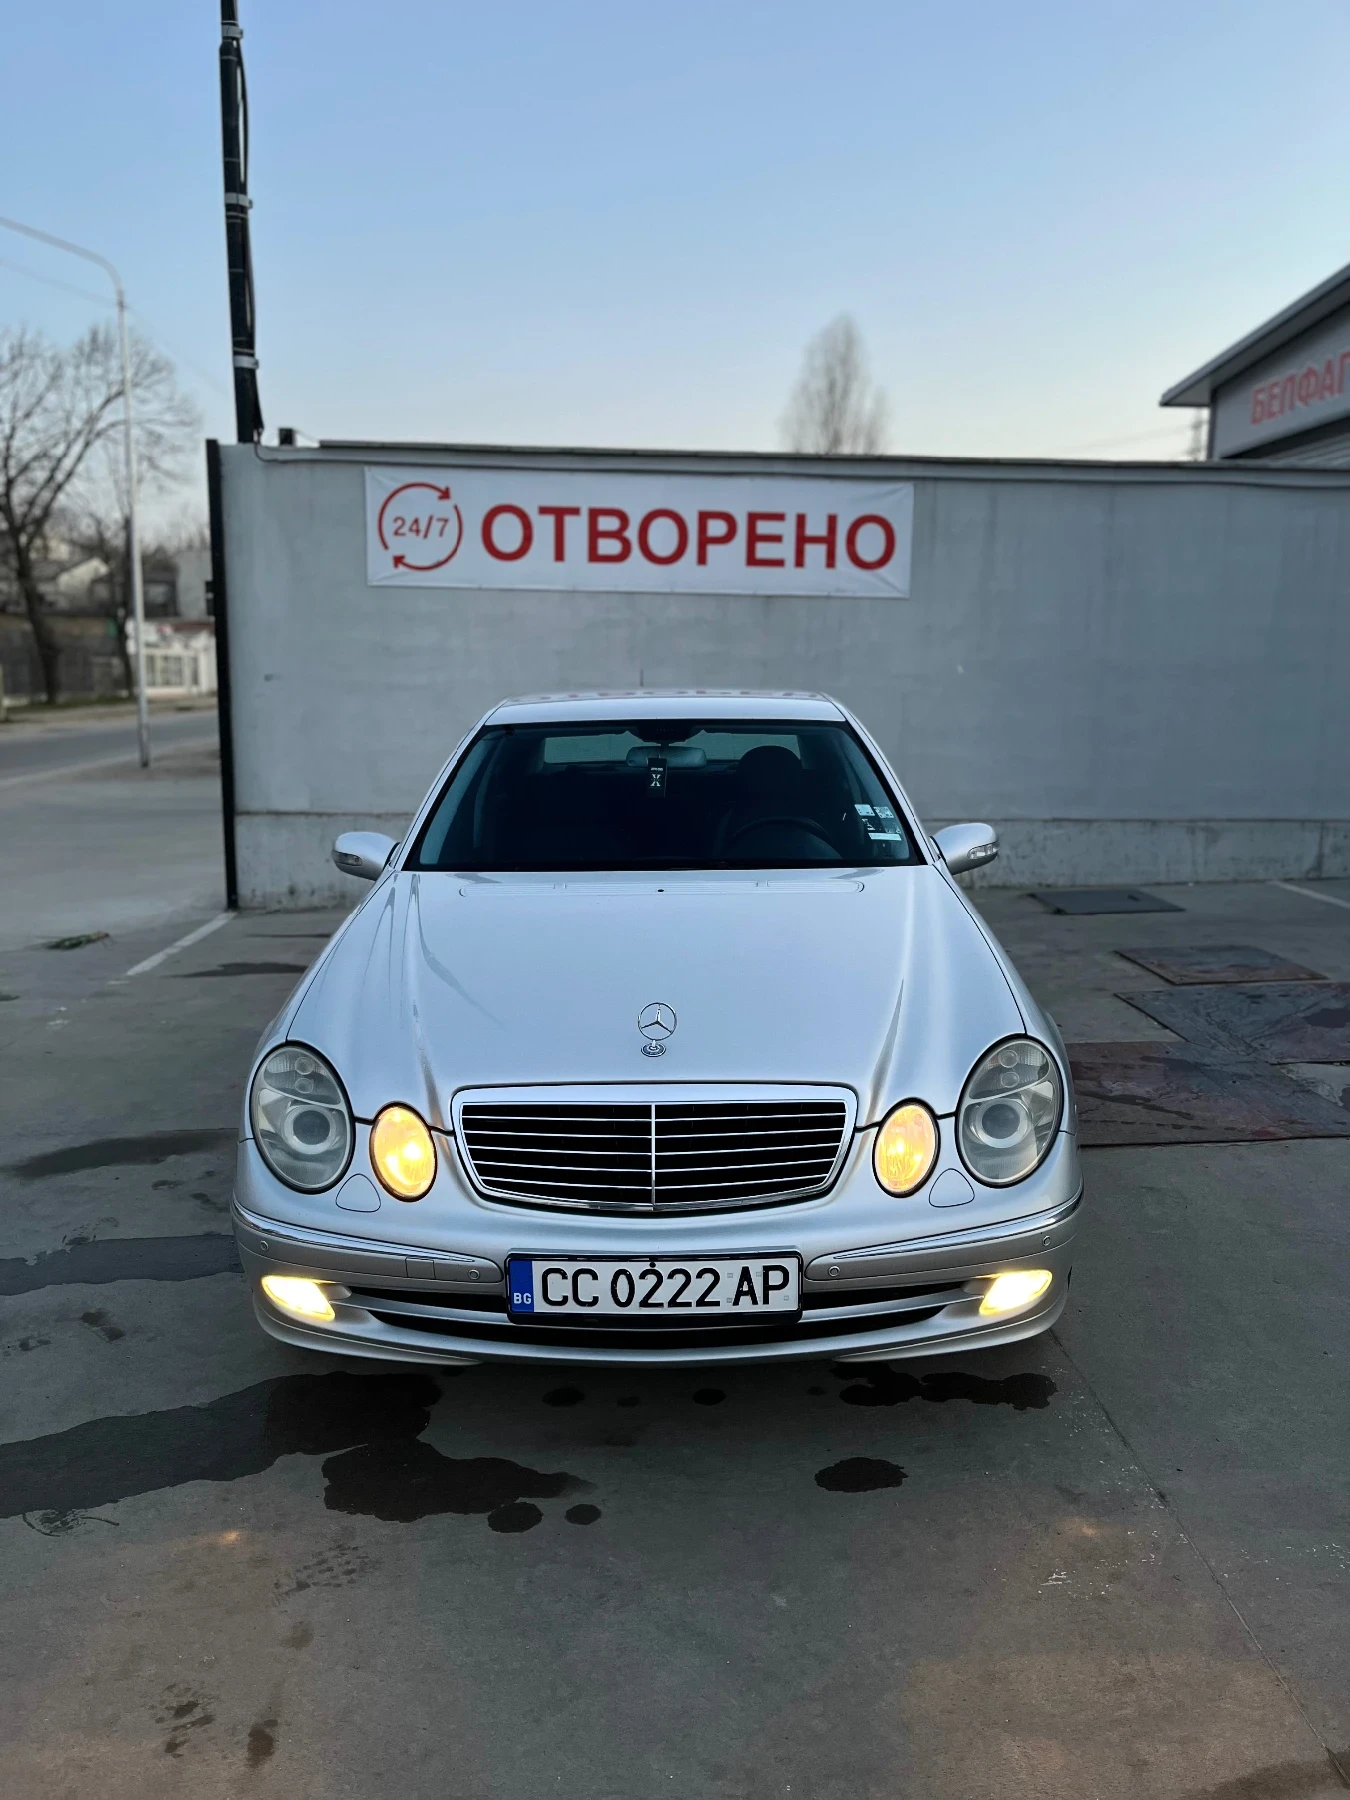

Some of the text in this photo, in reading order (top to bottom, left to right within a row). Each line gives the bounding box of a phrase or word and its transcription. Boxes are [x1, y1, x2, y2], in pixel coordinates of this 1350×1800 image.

[392, 516, 450, 540] 24/7
[481, 504, 897, 571] ОТВОРЕНО
[513, 1292, 532, 1305] BG
[541, 1264, 790, 1308] CC 0222 AP
